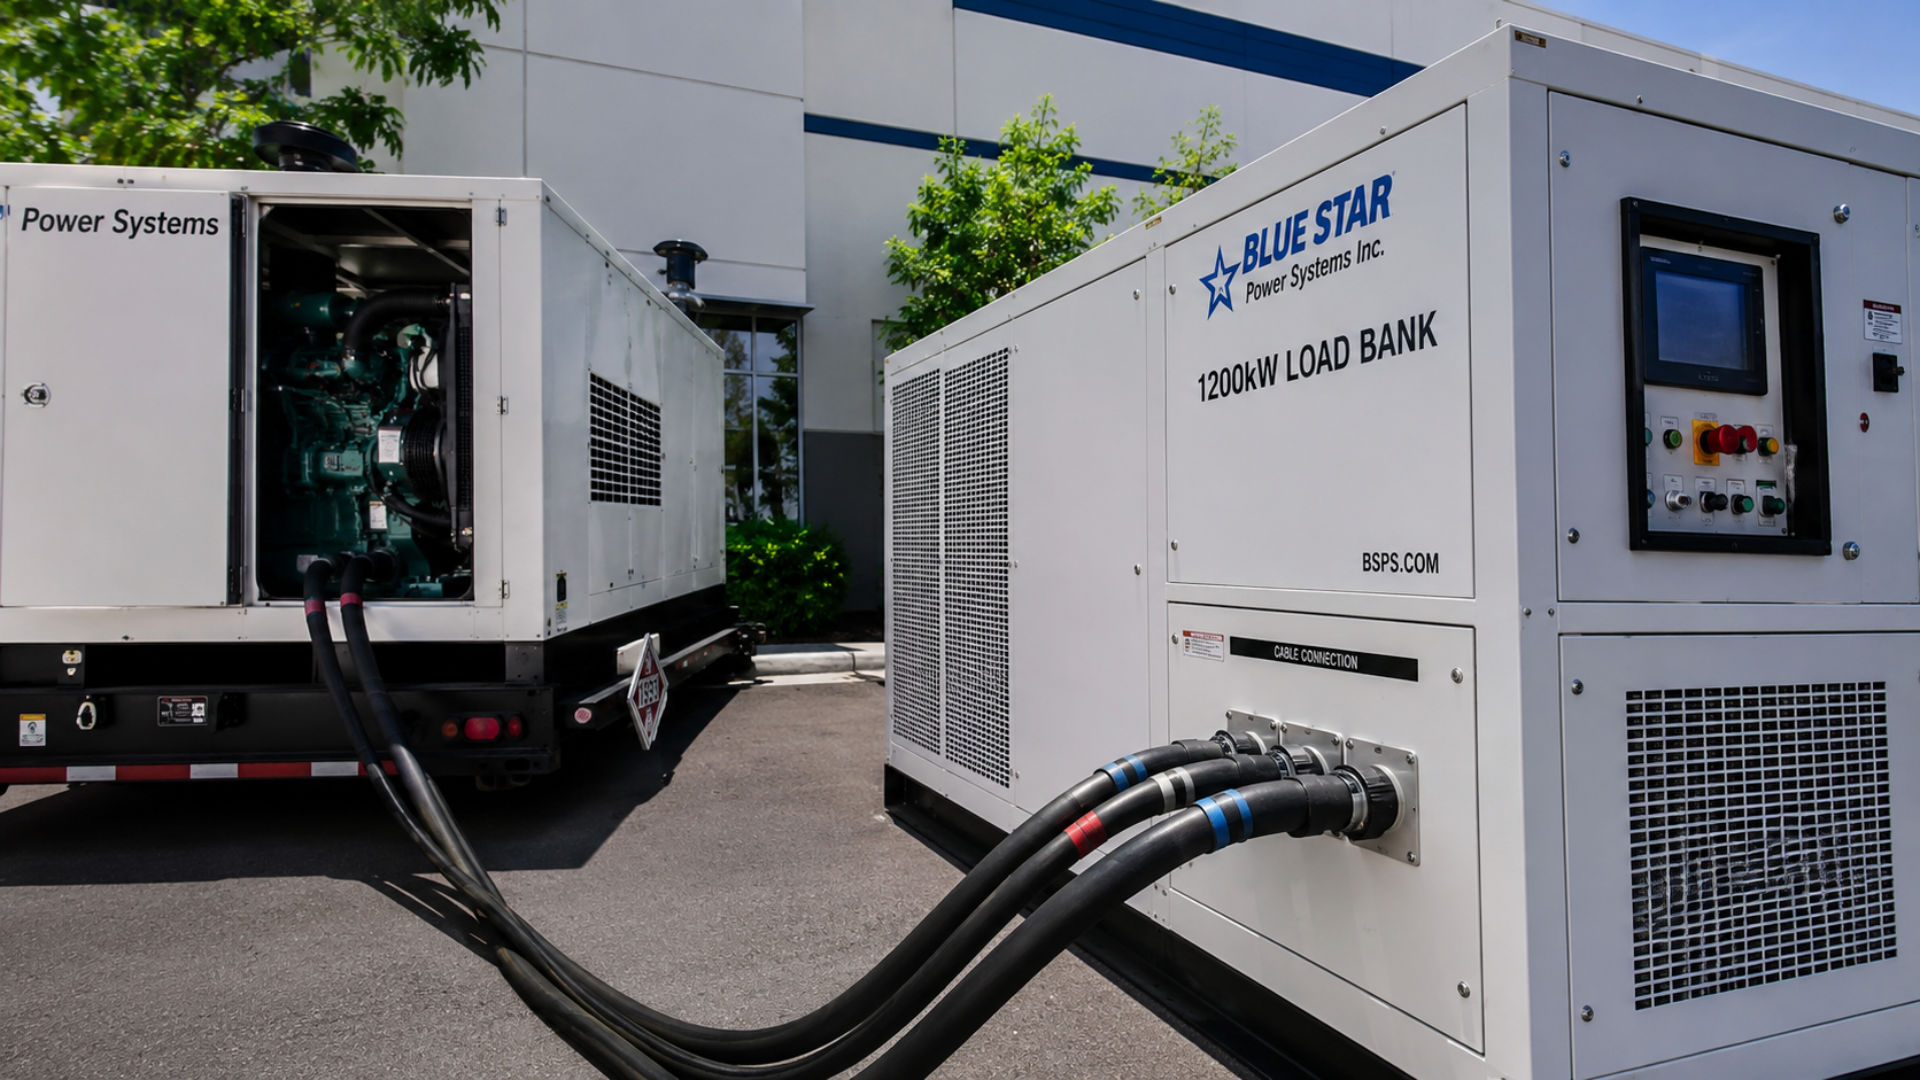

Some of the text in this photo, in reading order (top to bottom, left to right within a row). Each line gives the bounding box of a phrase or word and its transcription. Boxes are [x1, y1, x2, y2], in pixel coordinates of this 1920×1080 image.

[21, 207, 105, 232] Power
[112, 208, 219, 240] Systems
[1242, 174, 1393, 275] BLUE STAR
[1246, 239, 1385, 304] Power Systems Inc.
[1198, 310, 1438, 402] 1200kW LOAD BANK
[1362, 552, 1439, 574] BSPS.COM
[1274, 645, 1358, 670] CABLE CONNECTION
